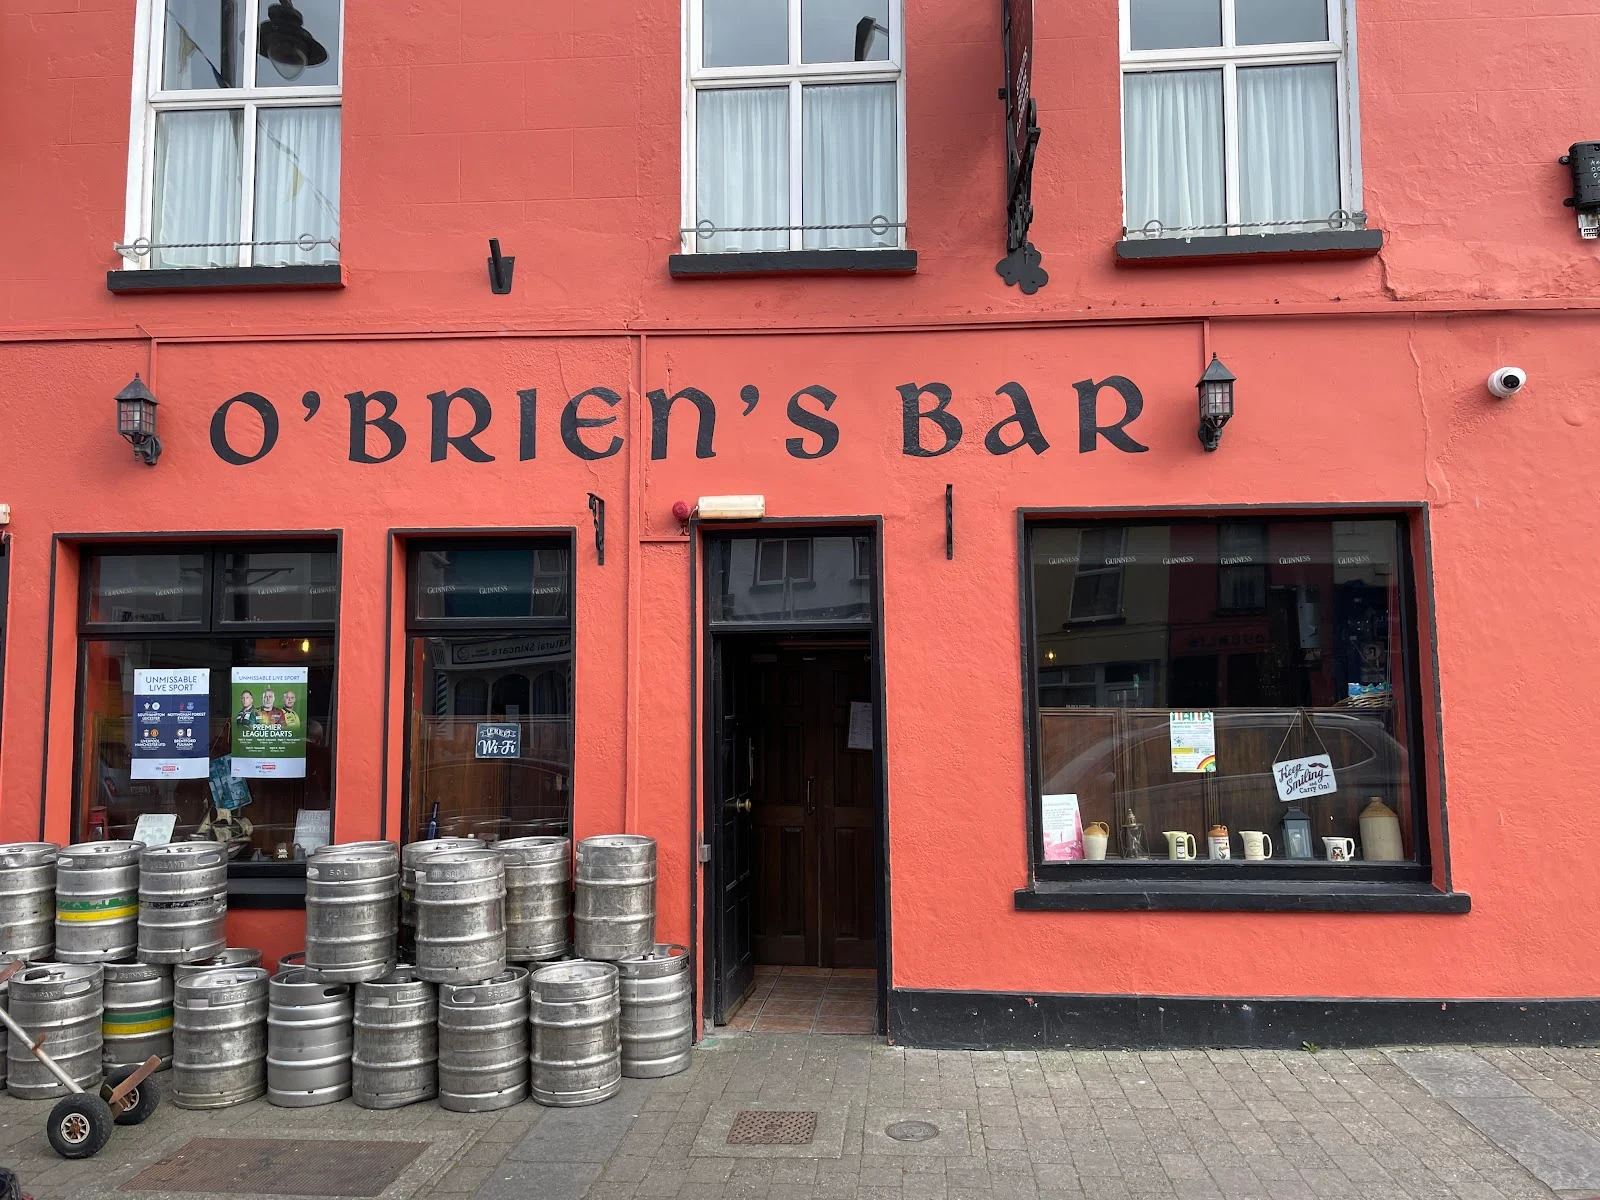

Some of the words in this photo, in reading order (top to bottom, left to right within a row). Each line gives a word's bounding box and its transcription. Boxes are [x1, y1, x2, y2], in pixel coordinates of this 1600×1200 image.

[895, 375, 1150, 458] BAR
[1048, 556, 1080, 565] GUINNESS
[1105, 555, 1137, 565] GUINNESS
[1162, 555, 1194, 565] GUINNESS
[1220, 555, 1253, 565] GUINNESS
[1278, 555, 1311, 565] GUINNESS
[1337, 555, 1370, 565] GUINNESS
[104, 588, 133, 597] GUINNESS
[155, 587, 184, 597] GUINNESS
[257, 586, 287, 596] GUINNESS
[427, 585, 456, 595] GUINNESS
[478, 585, 508, 595] GUINNESS
[532, 586, 561, 595] GUINNESS
[145, 675, 198, 684] UNMISSABLE
[149, 684, 167, 692] LIVE
[168, 683, 194, 692] SPORT
[252, 723, 282, 731] PREMIER
[478, 739, 517, 755] Wi-Fi
[1277, 763, 1305, 783] Keep
[1285, 768, 1331, 795] Smiling
[1299, 786, 1317, 794] Carry
[1318, 782, 1330, 790] On!
